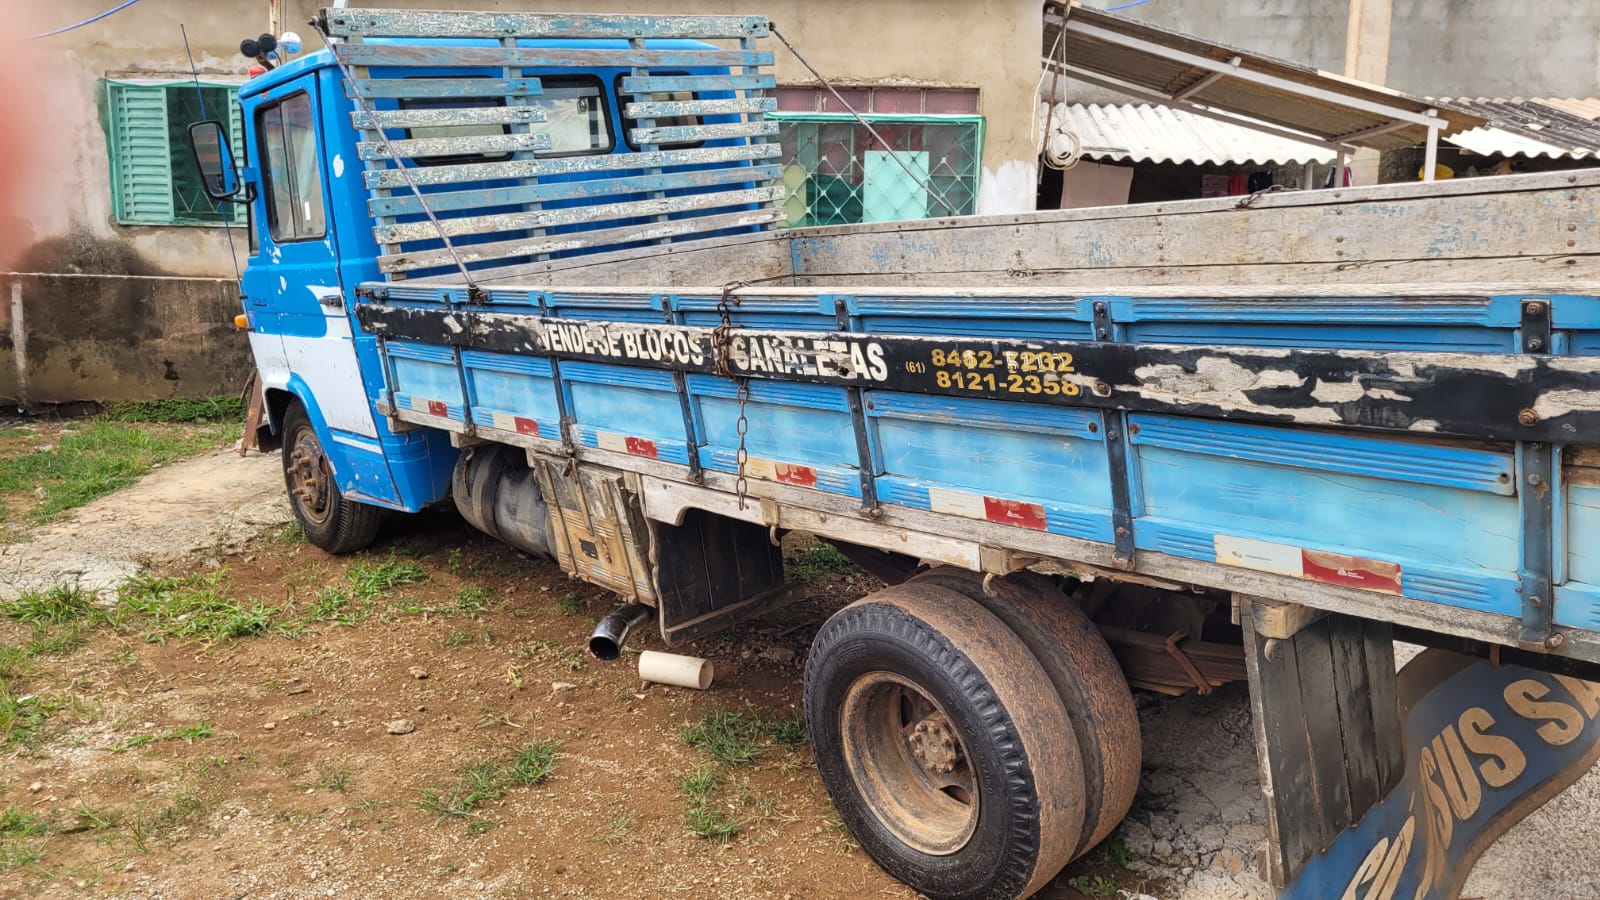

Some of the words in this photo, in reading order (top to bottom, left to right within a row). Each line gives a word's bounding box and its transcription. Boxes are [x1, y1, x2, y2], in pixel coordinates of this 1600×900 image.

[540, 322, 622, 357] VENDE-SE
[623, 329, 704, 366] BLOCOS
[905, 360, 926, 374] (61)
[936, 370, 1080, 396] 8121-2358
